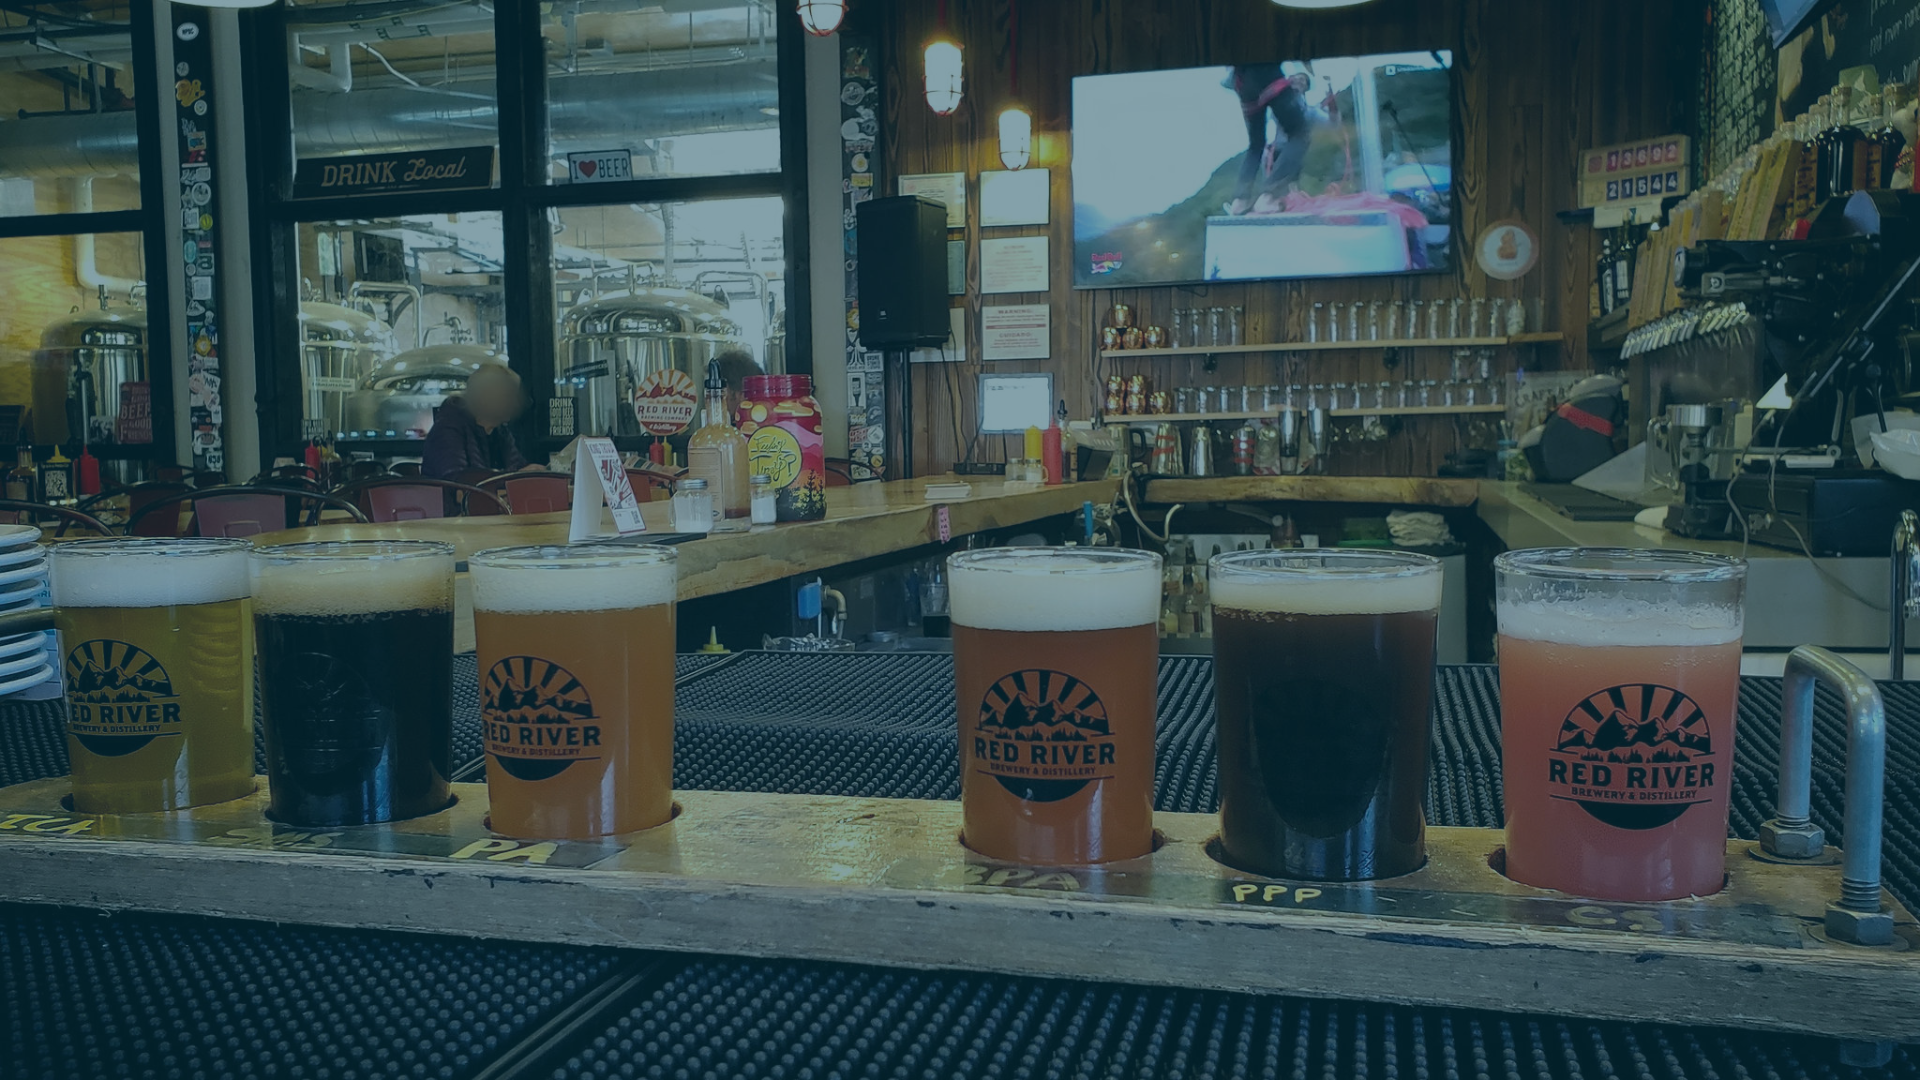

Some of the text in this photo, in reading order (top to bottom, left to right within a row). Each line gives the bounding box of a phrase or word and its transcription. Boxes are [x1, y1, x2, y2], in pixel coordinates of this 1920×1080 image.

[321, 155, 467, 187] DRINK Local
[573, 158, 629, 179] I BEER
[1609, 174, 1678, 198] 21544
[549, 397, 573, 407] DRINK
[638, 405, 692, 416] RED RIVER
[71, 702, 182, 723] ED RIVER
[110, 724, 161, 733] DISTILLERY
[519, 725, 602, 747] RIVER
[492, 743, 520, 755] BREWERY
[529, 748, 581, 756] DISTILLERY
[974, 736, 1116, 765] RED RIVER
[990, 762, 1096, 776] BREWERY & DISTILLERY
[1549, 758, 1715, 789] RED RIVER
[1571, 786, 1698, 801] BREWERY & DISTILLERY
[1232, 883, 1322, 903] PPP
